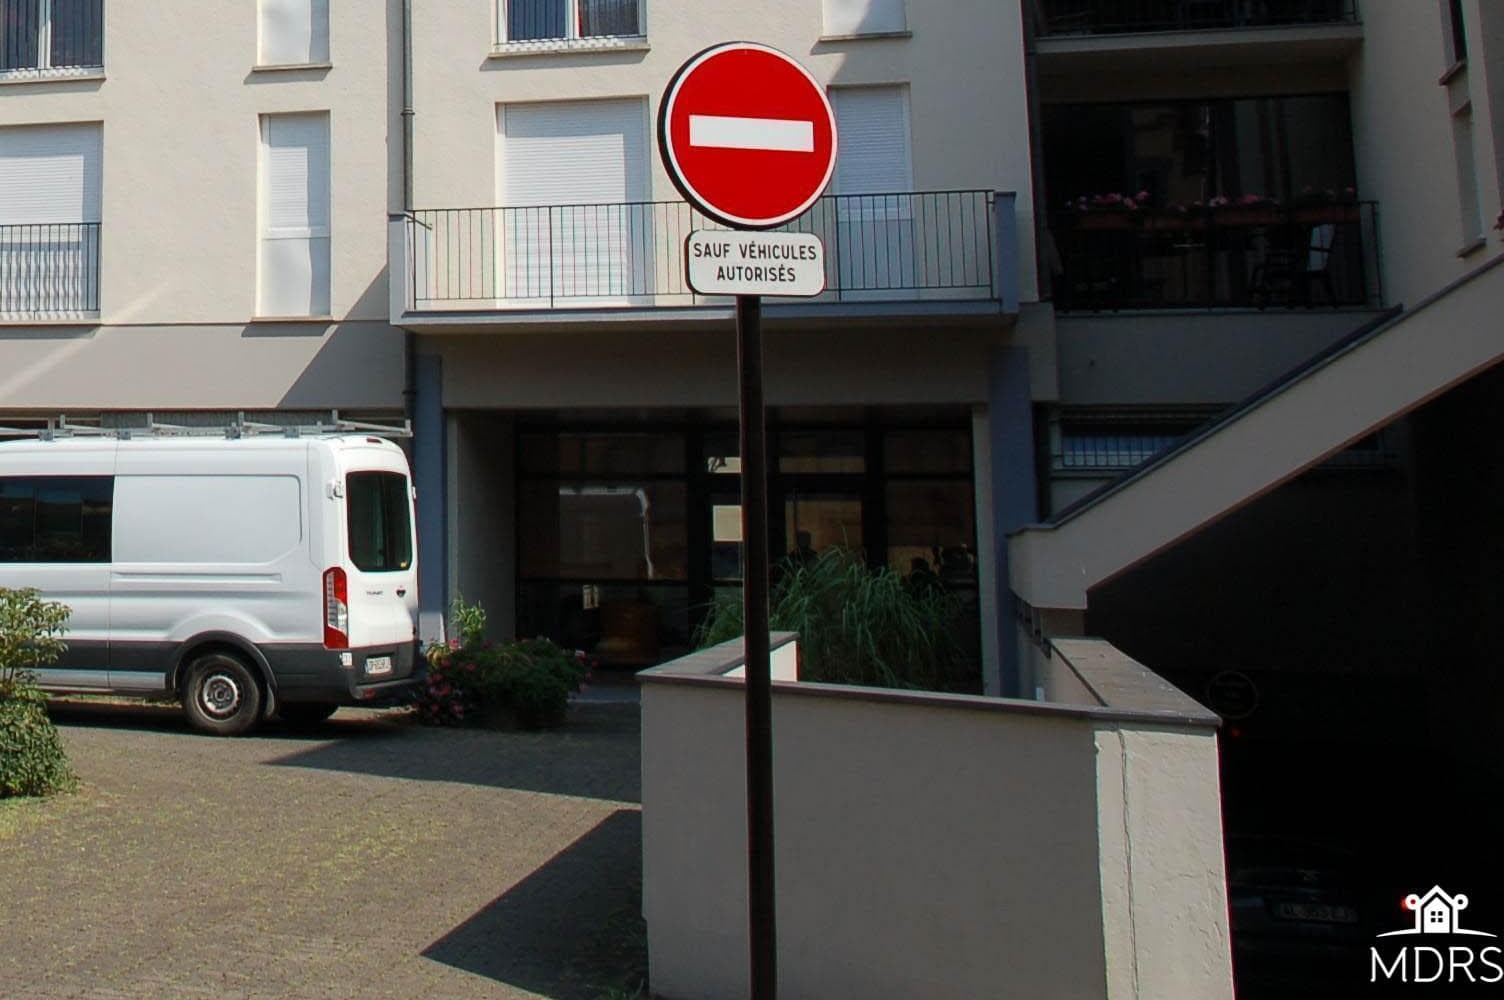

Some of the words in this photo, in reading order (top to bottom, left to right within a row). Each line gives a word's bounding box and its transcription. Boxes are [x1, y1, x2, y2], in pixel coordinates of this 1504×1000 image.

[693, 242, 731, 259] SAUF
[739, 240, 817, 261] VÉHICULES
[716, 264, 796, 282] AUTORISÉS
